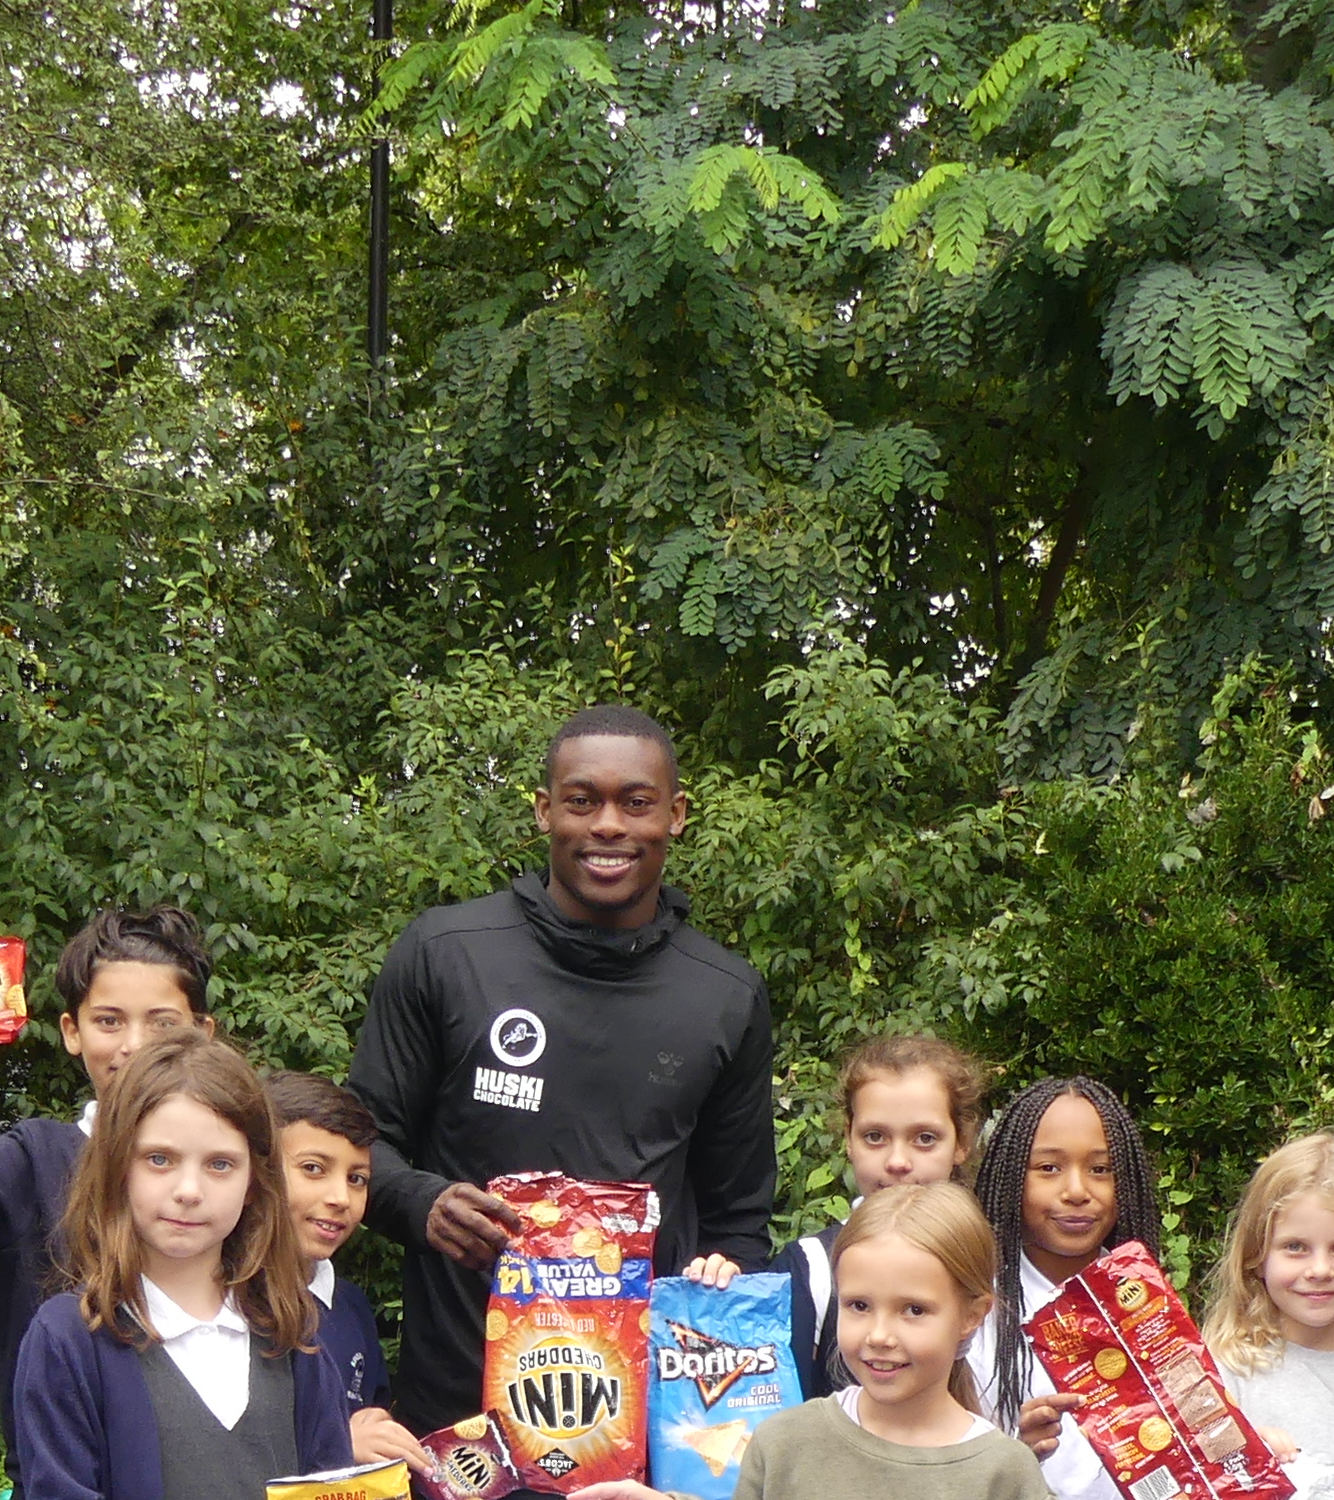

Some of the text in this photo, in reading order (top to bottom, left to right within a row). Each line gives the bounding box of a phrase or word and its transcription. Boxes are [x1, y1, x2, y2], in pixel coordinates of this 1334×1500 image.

[475, 1067, 544, 1100] HUSKI
[473, 1089, 540, 1112] CHOCOLATE
[498, 1266, 533, 1294] 14
[538, 1263, 596, 1278] VALUE
[544, 1278, 621, 1297] GREAT
[520, 1347, 602, 1371] CHEDDARS
[660, 1346, 775, 1378] Doritos
[750, 1384, 779, 1396] COOL
[727, 1396, 781, 1408] ORIGINAL
